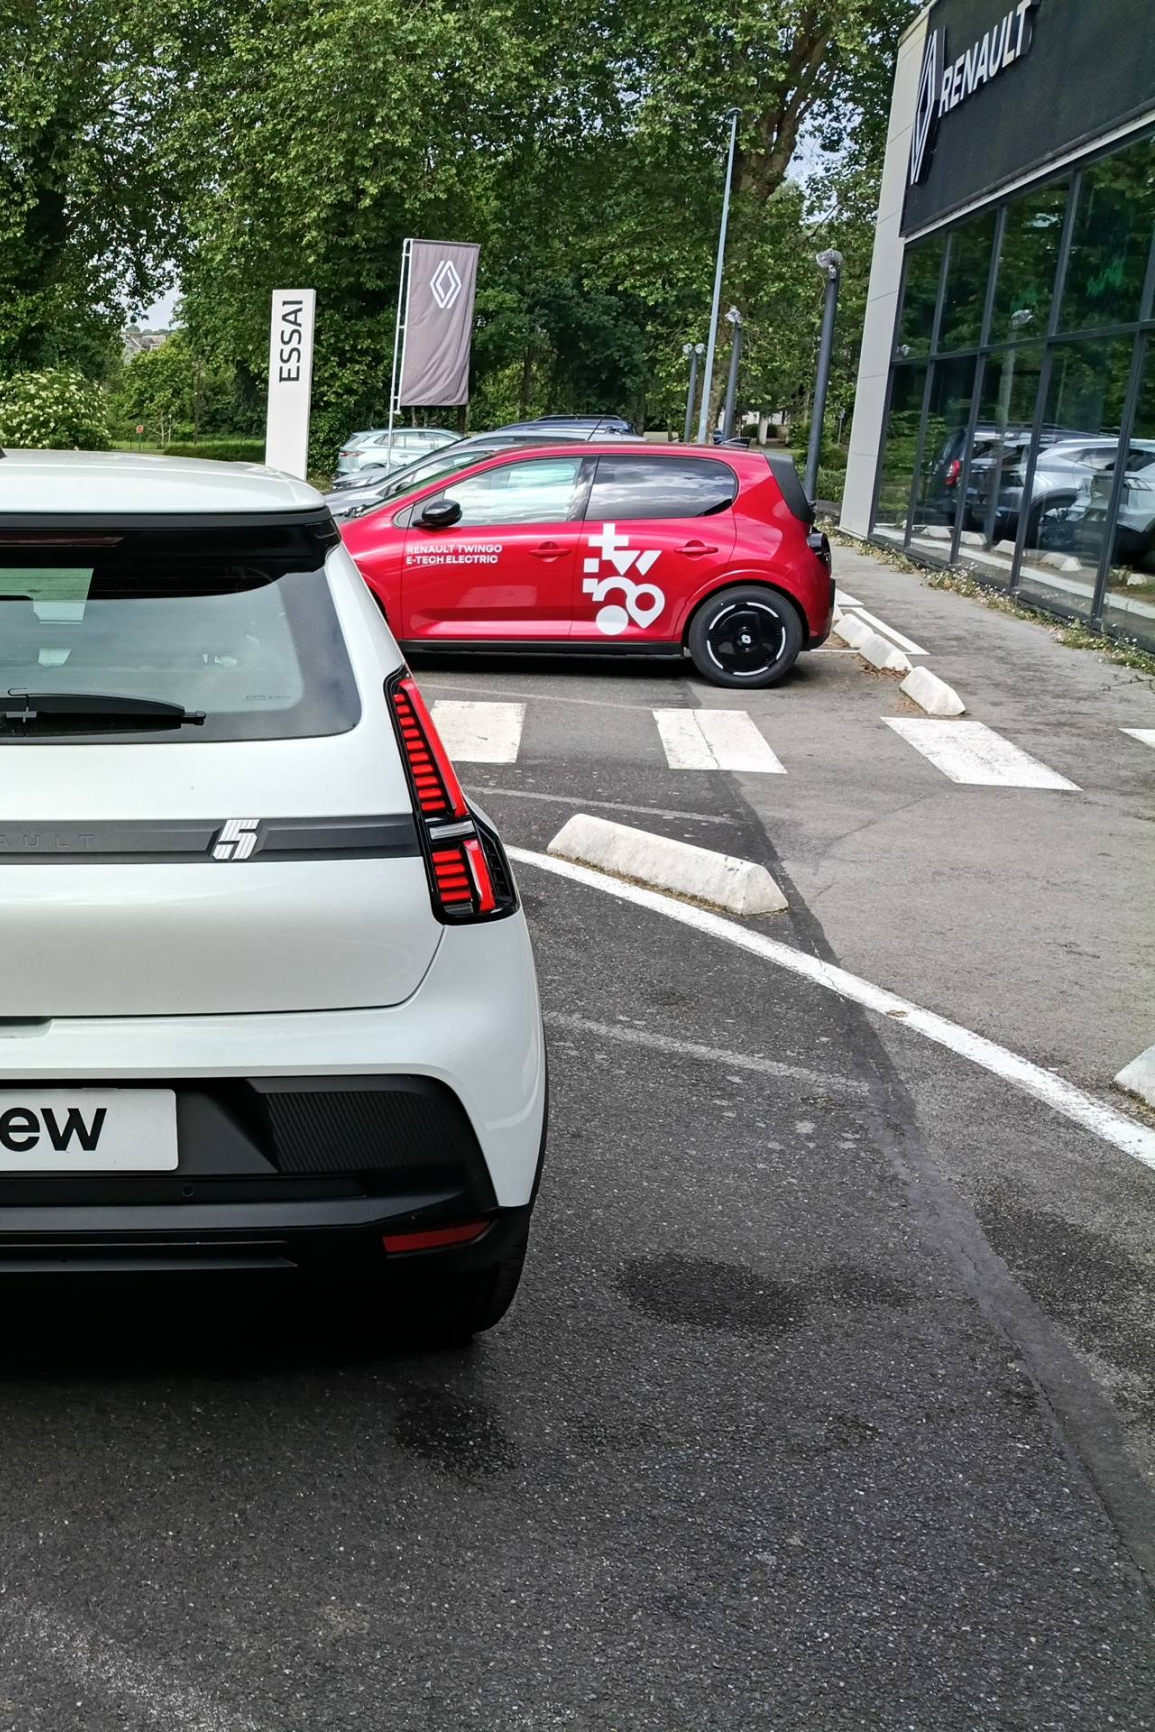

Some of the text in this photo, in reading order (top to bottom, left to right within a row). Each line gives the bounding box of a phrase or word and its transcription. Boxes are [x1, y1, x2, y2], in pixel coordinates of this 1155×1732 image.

[938, 0, 1032, 118] RENAULT
[279, 300, 303, 383] ESSAI
[406, 544, 503, 554] RENAULT TWINGO
[406, 555, 499, 565] E-TECH ELECTRIC
[212, 819, 261, 861] 5
